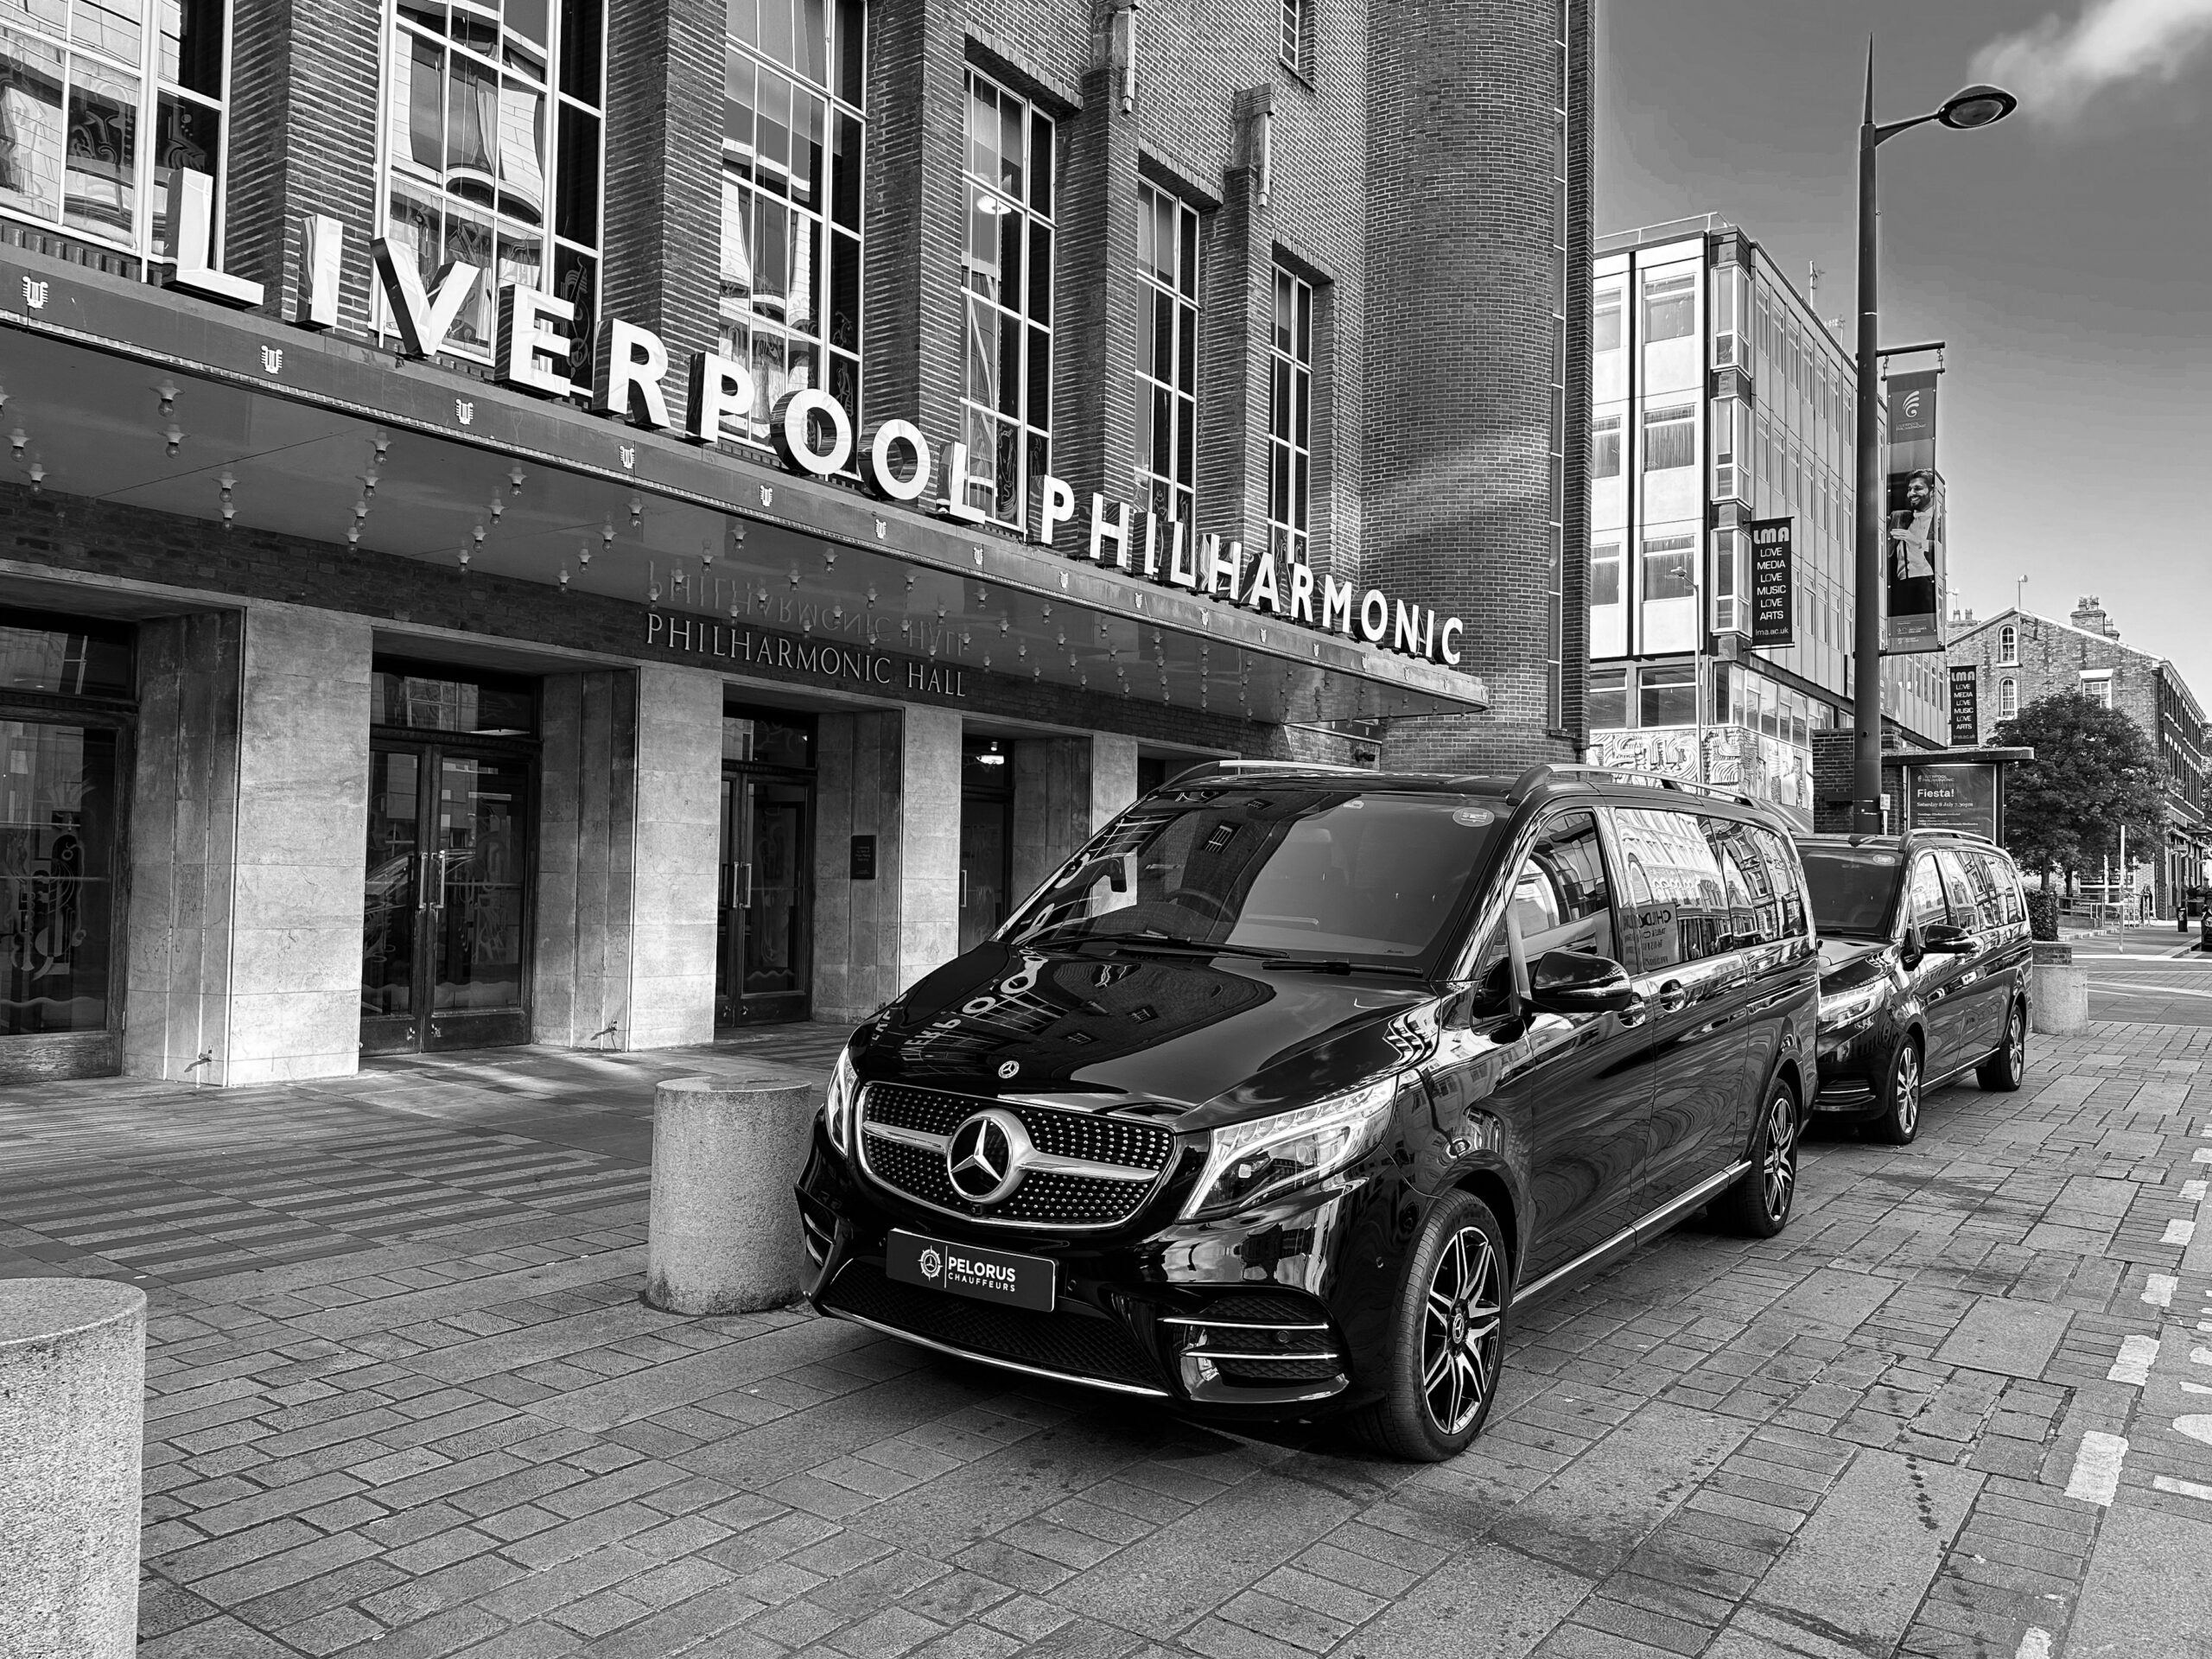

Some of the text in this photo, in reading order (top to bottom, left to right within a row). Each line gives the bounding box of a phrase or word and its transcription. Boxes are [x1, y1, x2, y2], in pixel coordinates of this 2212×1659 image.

[164, 167, 1464, 665] LIVERPOOL PHILHARMONIC
[1753, 526, 1789, 544] LMA
[1760, 547, 1783, 557] LOVE
[1757, 559, 1786, 570] MEDIA
[1760, 572, 1783, 582] LOVE
[1757, 584, 1787, 596] MUSIC
[1760, 597, 1783, 608] LOVE
[1759, 610, 1784, 621] ARTS
[1755, 626, 1789, 636] lma.ac.uk
[646, 613, 966, 697] PHILHARMONIC HALL
[1951, 671, 1975, 682] LMA
[1917, 788, 1955, 798] Fiesta!
[948, 1256, 1016, 1282] PELORUS
[948, 1272, 1016, 1293] CHAUFFEURS
